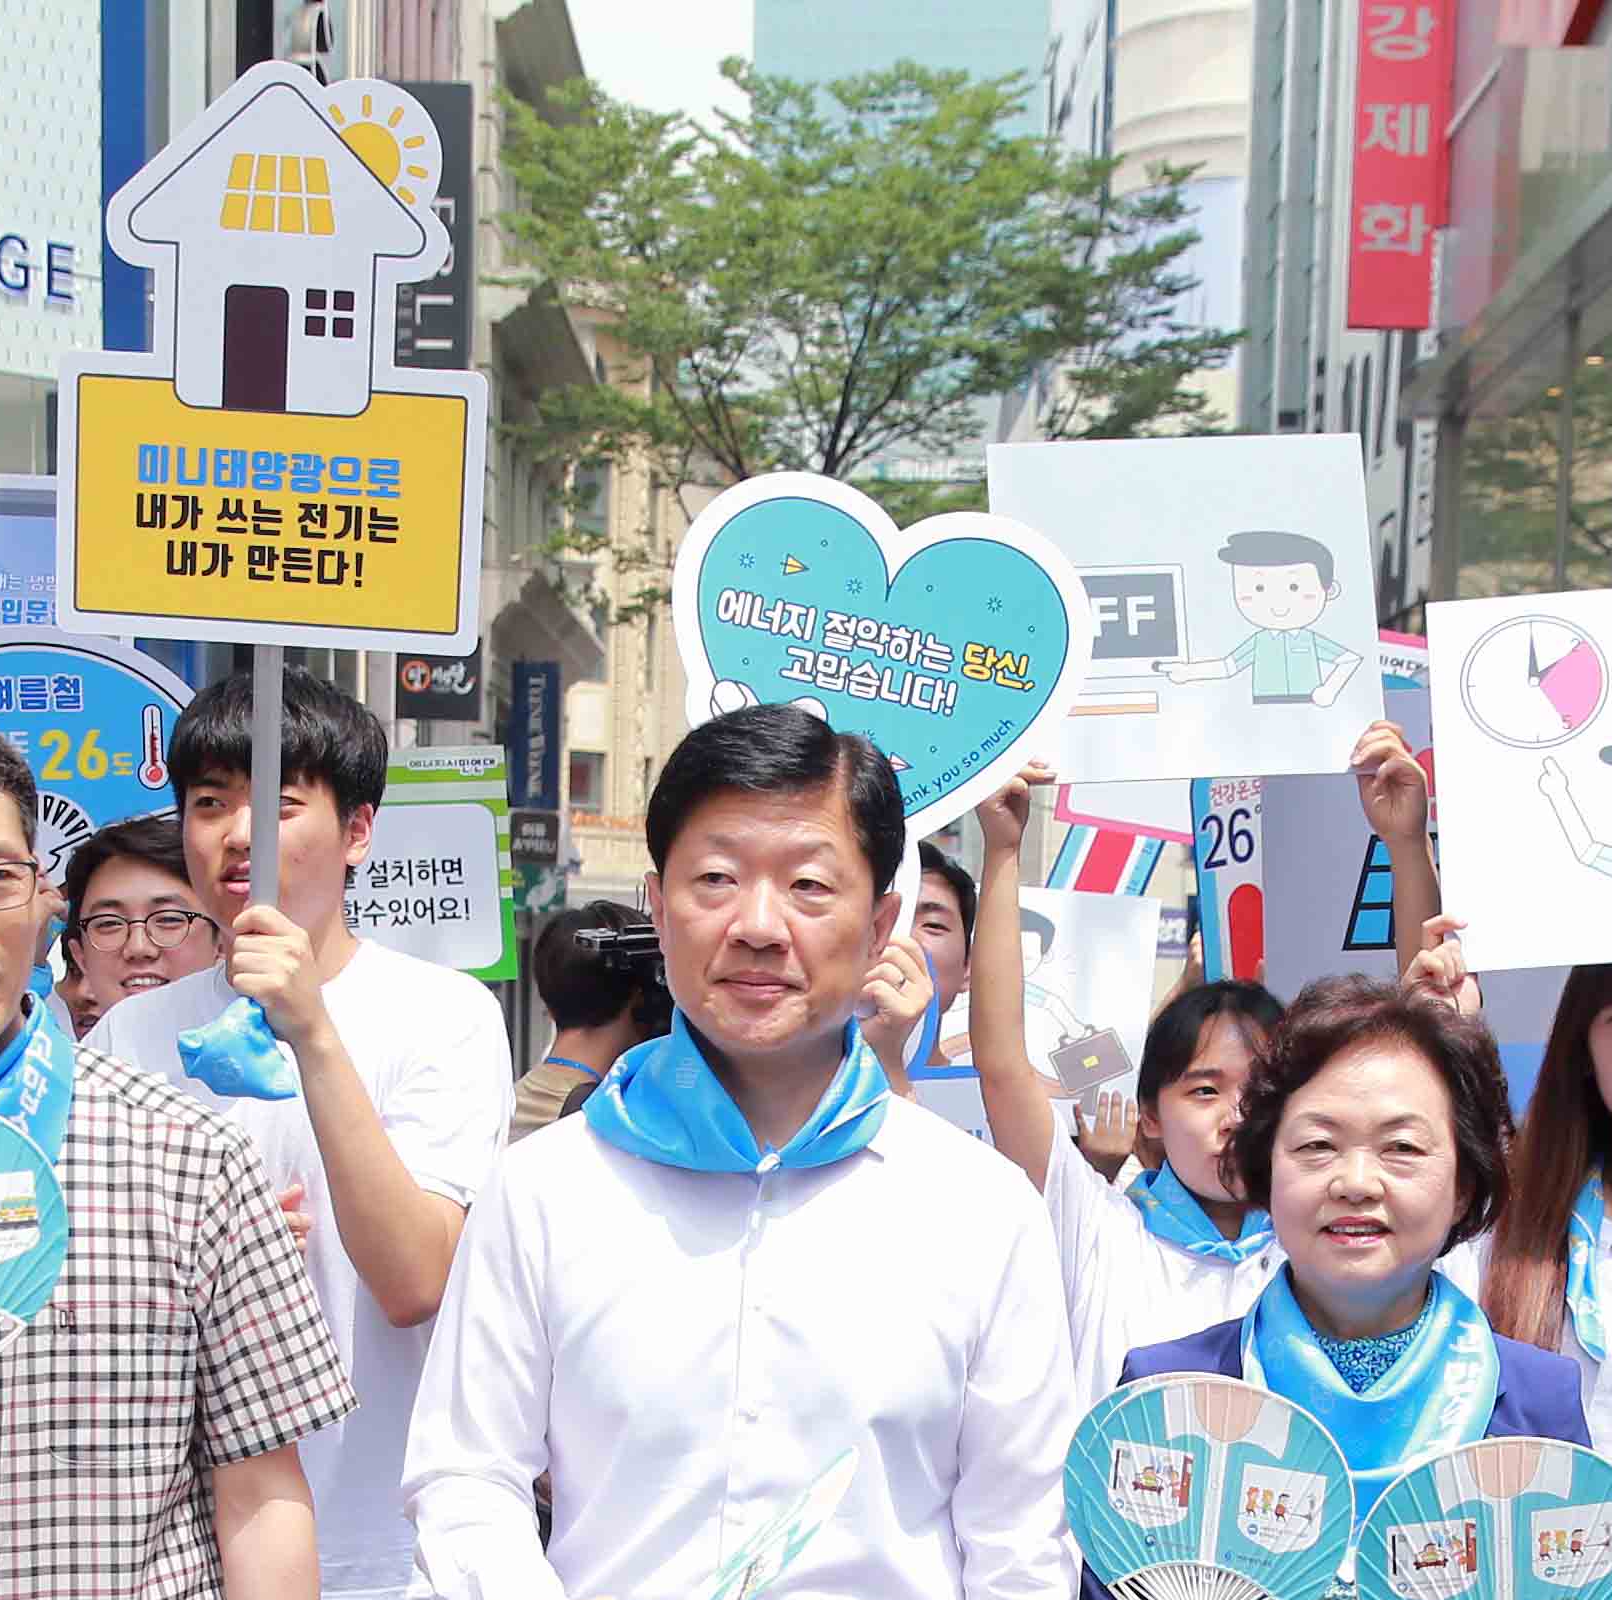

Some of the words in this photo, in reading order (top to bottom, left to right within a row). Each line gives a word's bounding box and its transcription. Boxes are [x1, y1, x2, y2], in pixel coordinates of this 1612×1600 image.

[138, 443, 401, 499] 미니태양광으로
[136, 493, 203, 531] 내가
[216, 497, 283, 537] 쓰는
[297, 502, 400, 544] 전기는
[166, 539, 234, 578] 내가
[247, 544, 364, 588] 만든다!
[717, 588, 818, 641] 에너지
[823, 610, 955, 673] 절약하는
[961, 641, 1036, 691] 당신,
[1090, 595, 1157, 637] FF
[779, 646, 958, 717] 고맙습니다!
[39, 728, 133, 781] 26도
[408, 758, 496, 776] 에너지시민연대
[903, 783, 931, 807] ank
[932, 766, 961, 794] you
[963, 750, 981, 769] so
[979, 717, 1016, 751] much
[366, 856, 465, 889] 설치하면
